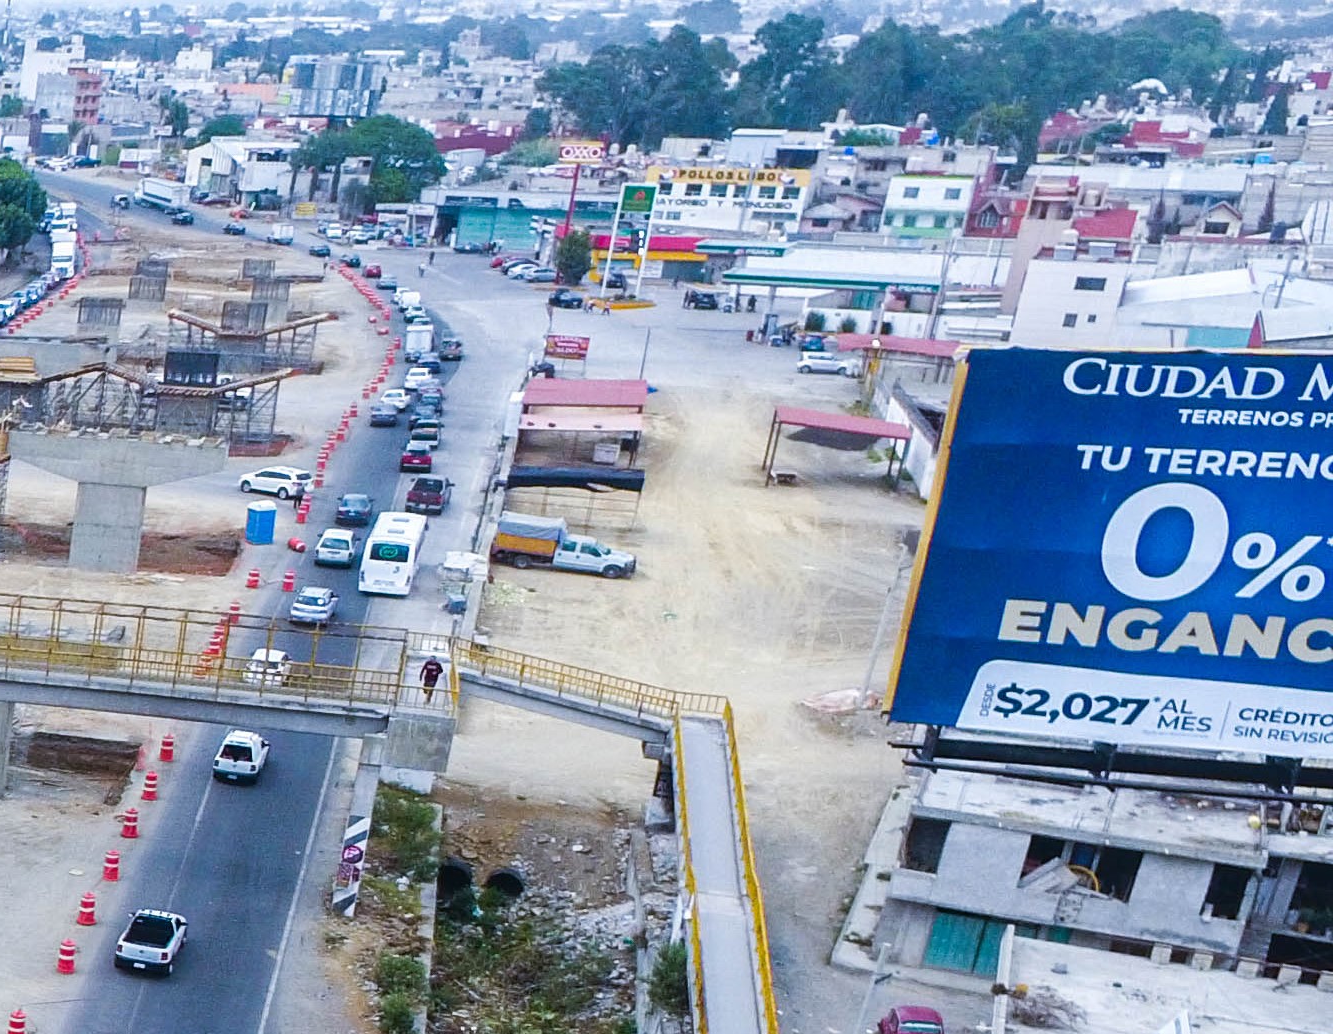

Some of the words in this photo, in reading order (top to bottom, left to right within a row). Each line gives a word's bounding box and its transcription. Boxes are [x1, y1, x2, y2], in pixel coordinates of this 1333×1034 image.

[562, 146, 601, 159] OXXO
[679, 169, 733, 180] POLLOS
[656, 198, 708, 207] AYOREO
[1063, 357, 1285, 400] CIUDAD
[1179, 408, 1303, 428] TERRENOS
[1077, 444, 1132, 471] TU
[998, 599, 1333, 664] ENGANC
[979, 683, 996, 717] DESDE
[1159, 698, 1192, 715] AL
[1157, 714, 1212, 733] MES
[1234, 725, 1262, 739] SIN
